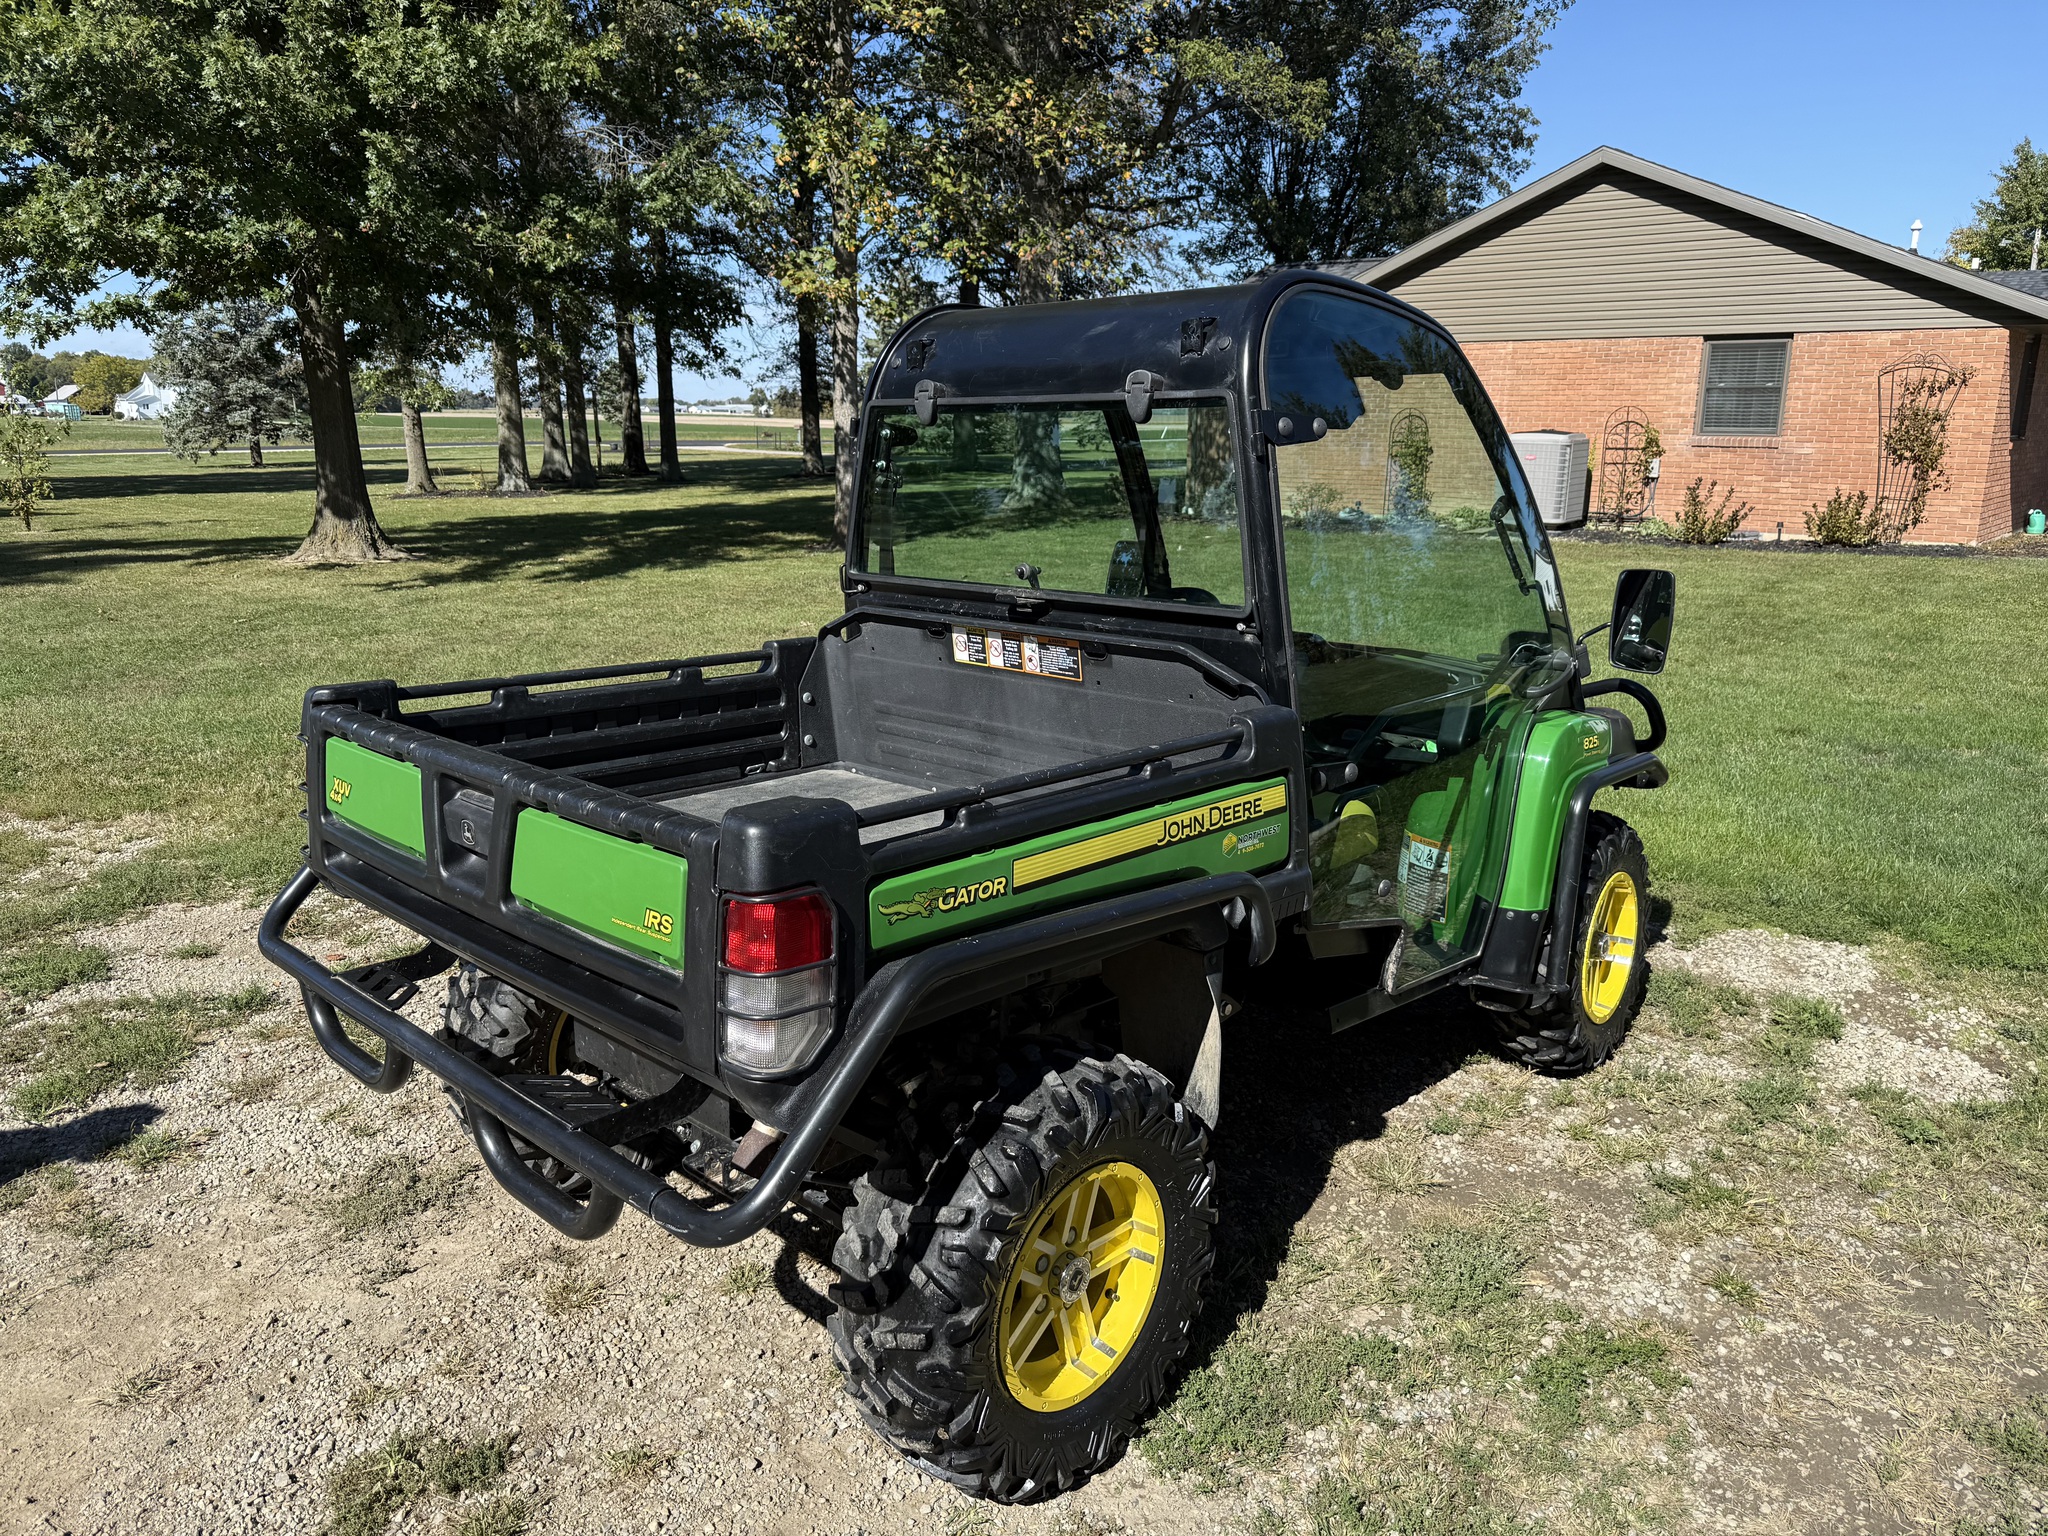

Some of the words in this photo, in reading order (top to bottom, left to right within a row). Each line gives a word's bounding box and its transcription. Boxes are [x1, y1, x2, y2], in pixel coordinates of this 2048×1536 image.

[333, 776, 352, 798] XUV
[1157, 813, 1205, 844] JOHN
[1209, 797, 1263, 828] DEERE
[1237, 824, 1281, 844] NORTHWEST
[938, 876, 1008, 912] GATOR
[643, 907, 674, 935] IRS
